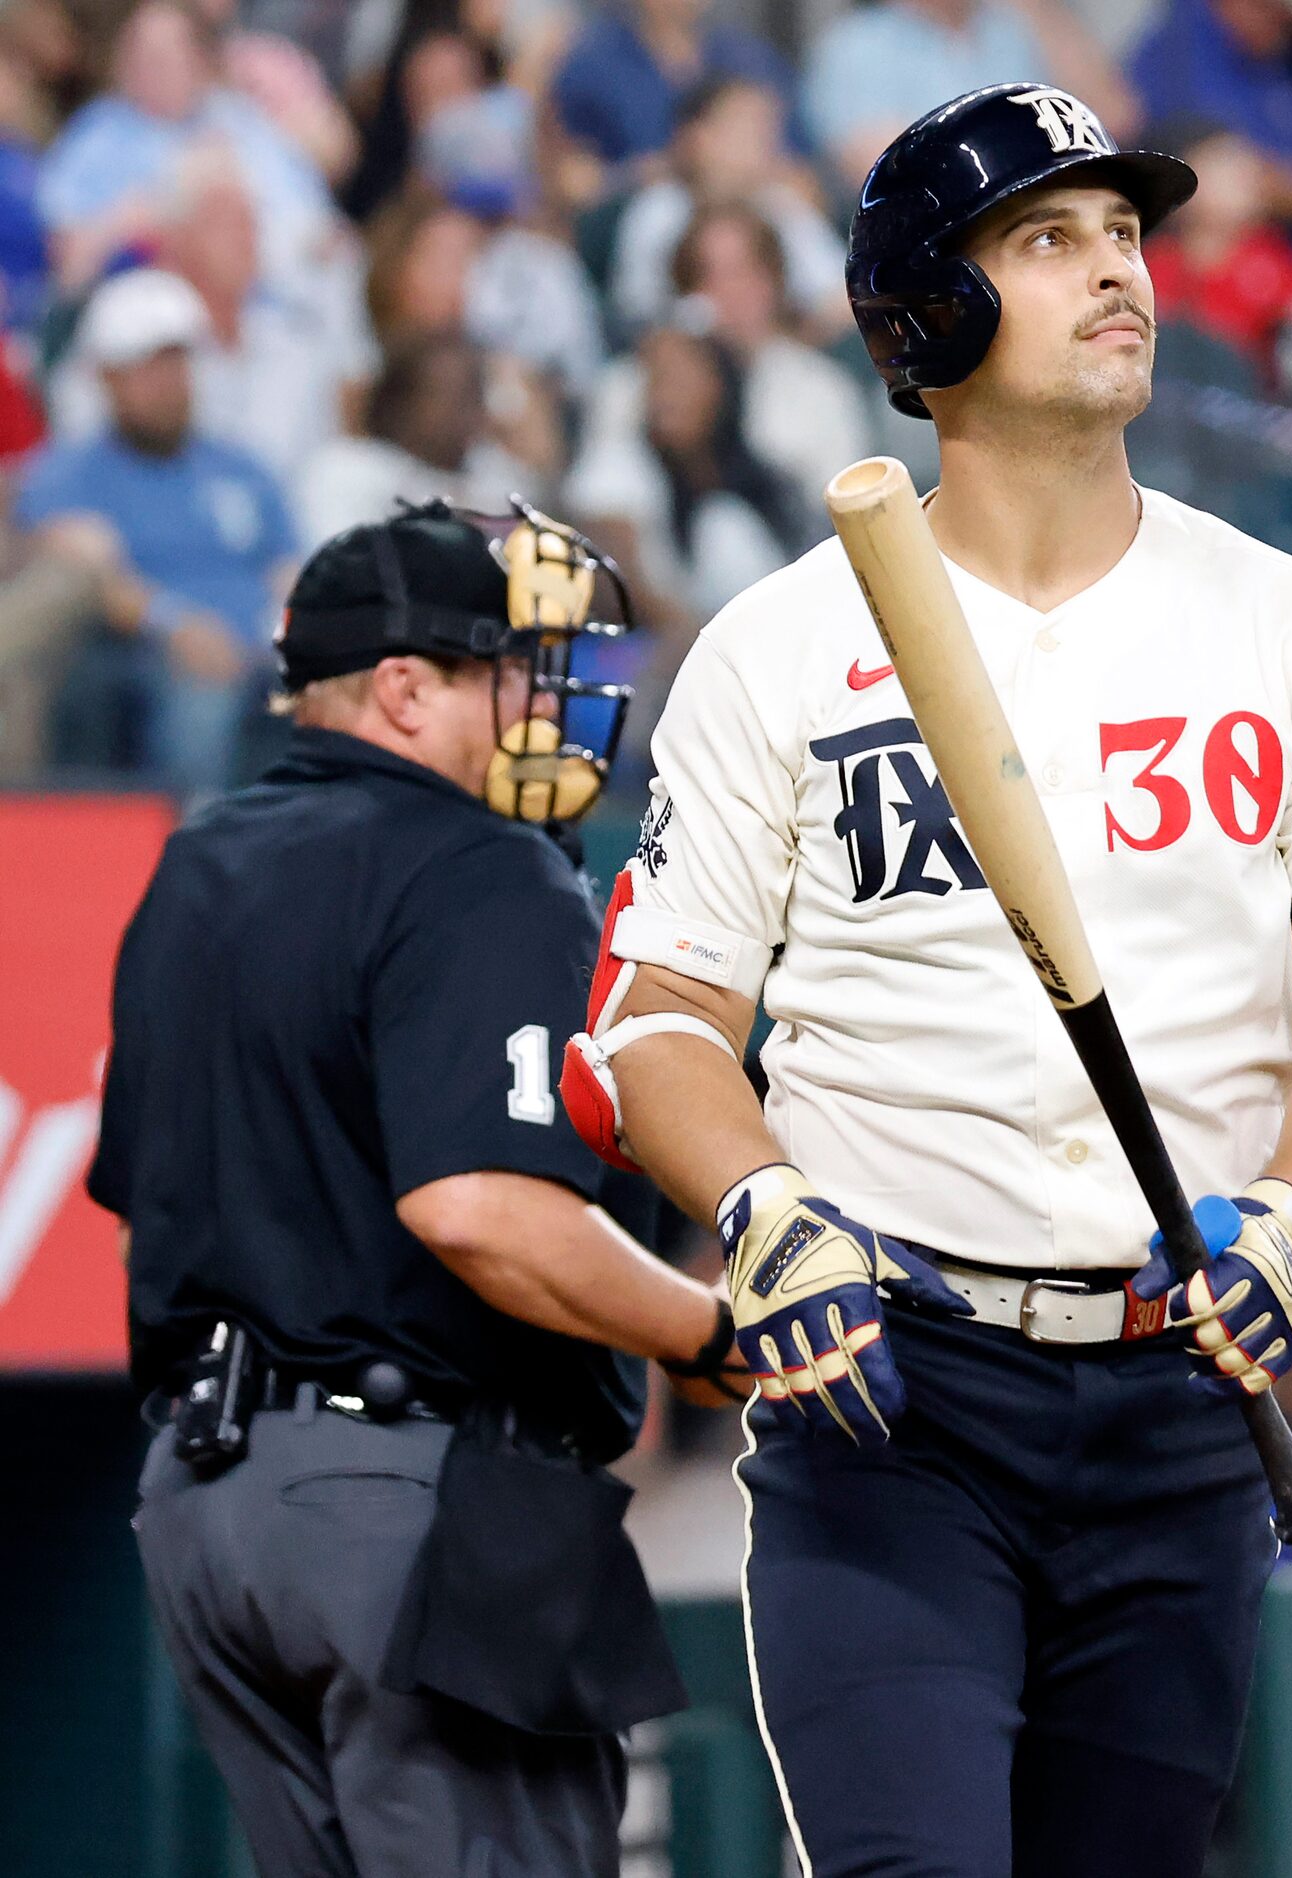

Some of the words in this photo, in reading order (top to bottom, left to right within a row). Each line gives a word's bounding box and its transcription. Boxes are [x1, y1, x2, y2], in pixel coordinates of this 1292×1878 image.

[1099, 710, 1284, 853] 30
[1009, 908, 1067, 987] marucci
[506, 1024, 556, 1127] 1
[1132, 1300, 1160, 1335] 30
